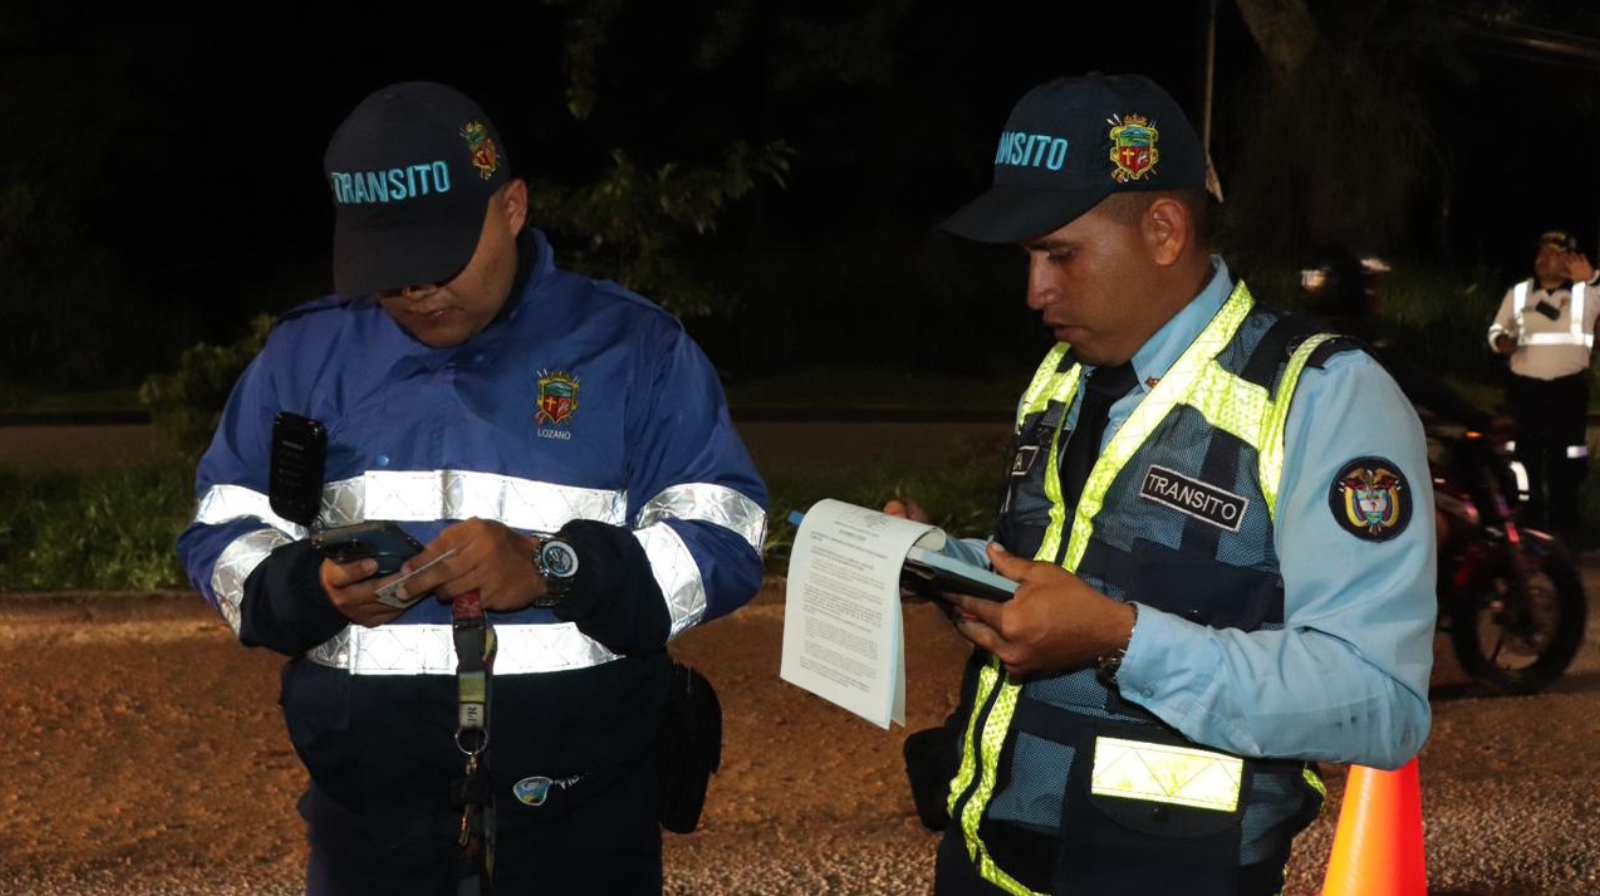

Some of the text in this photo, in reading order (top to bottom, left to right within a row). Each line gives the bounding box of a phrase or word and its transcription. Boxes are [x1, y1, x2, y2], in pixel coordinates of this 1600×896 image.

[331, 160, 450, 204] TRANSITO
[537, 428, 571, 440] LOZANO
[1148, 473, 1237, 520] TRANSITO
